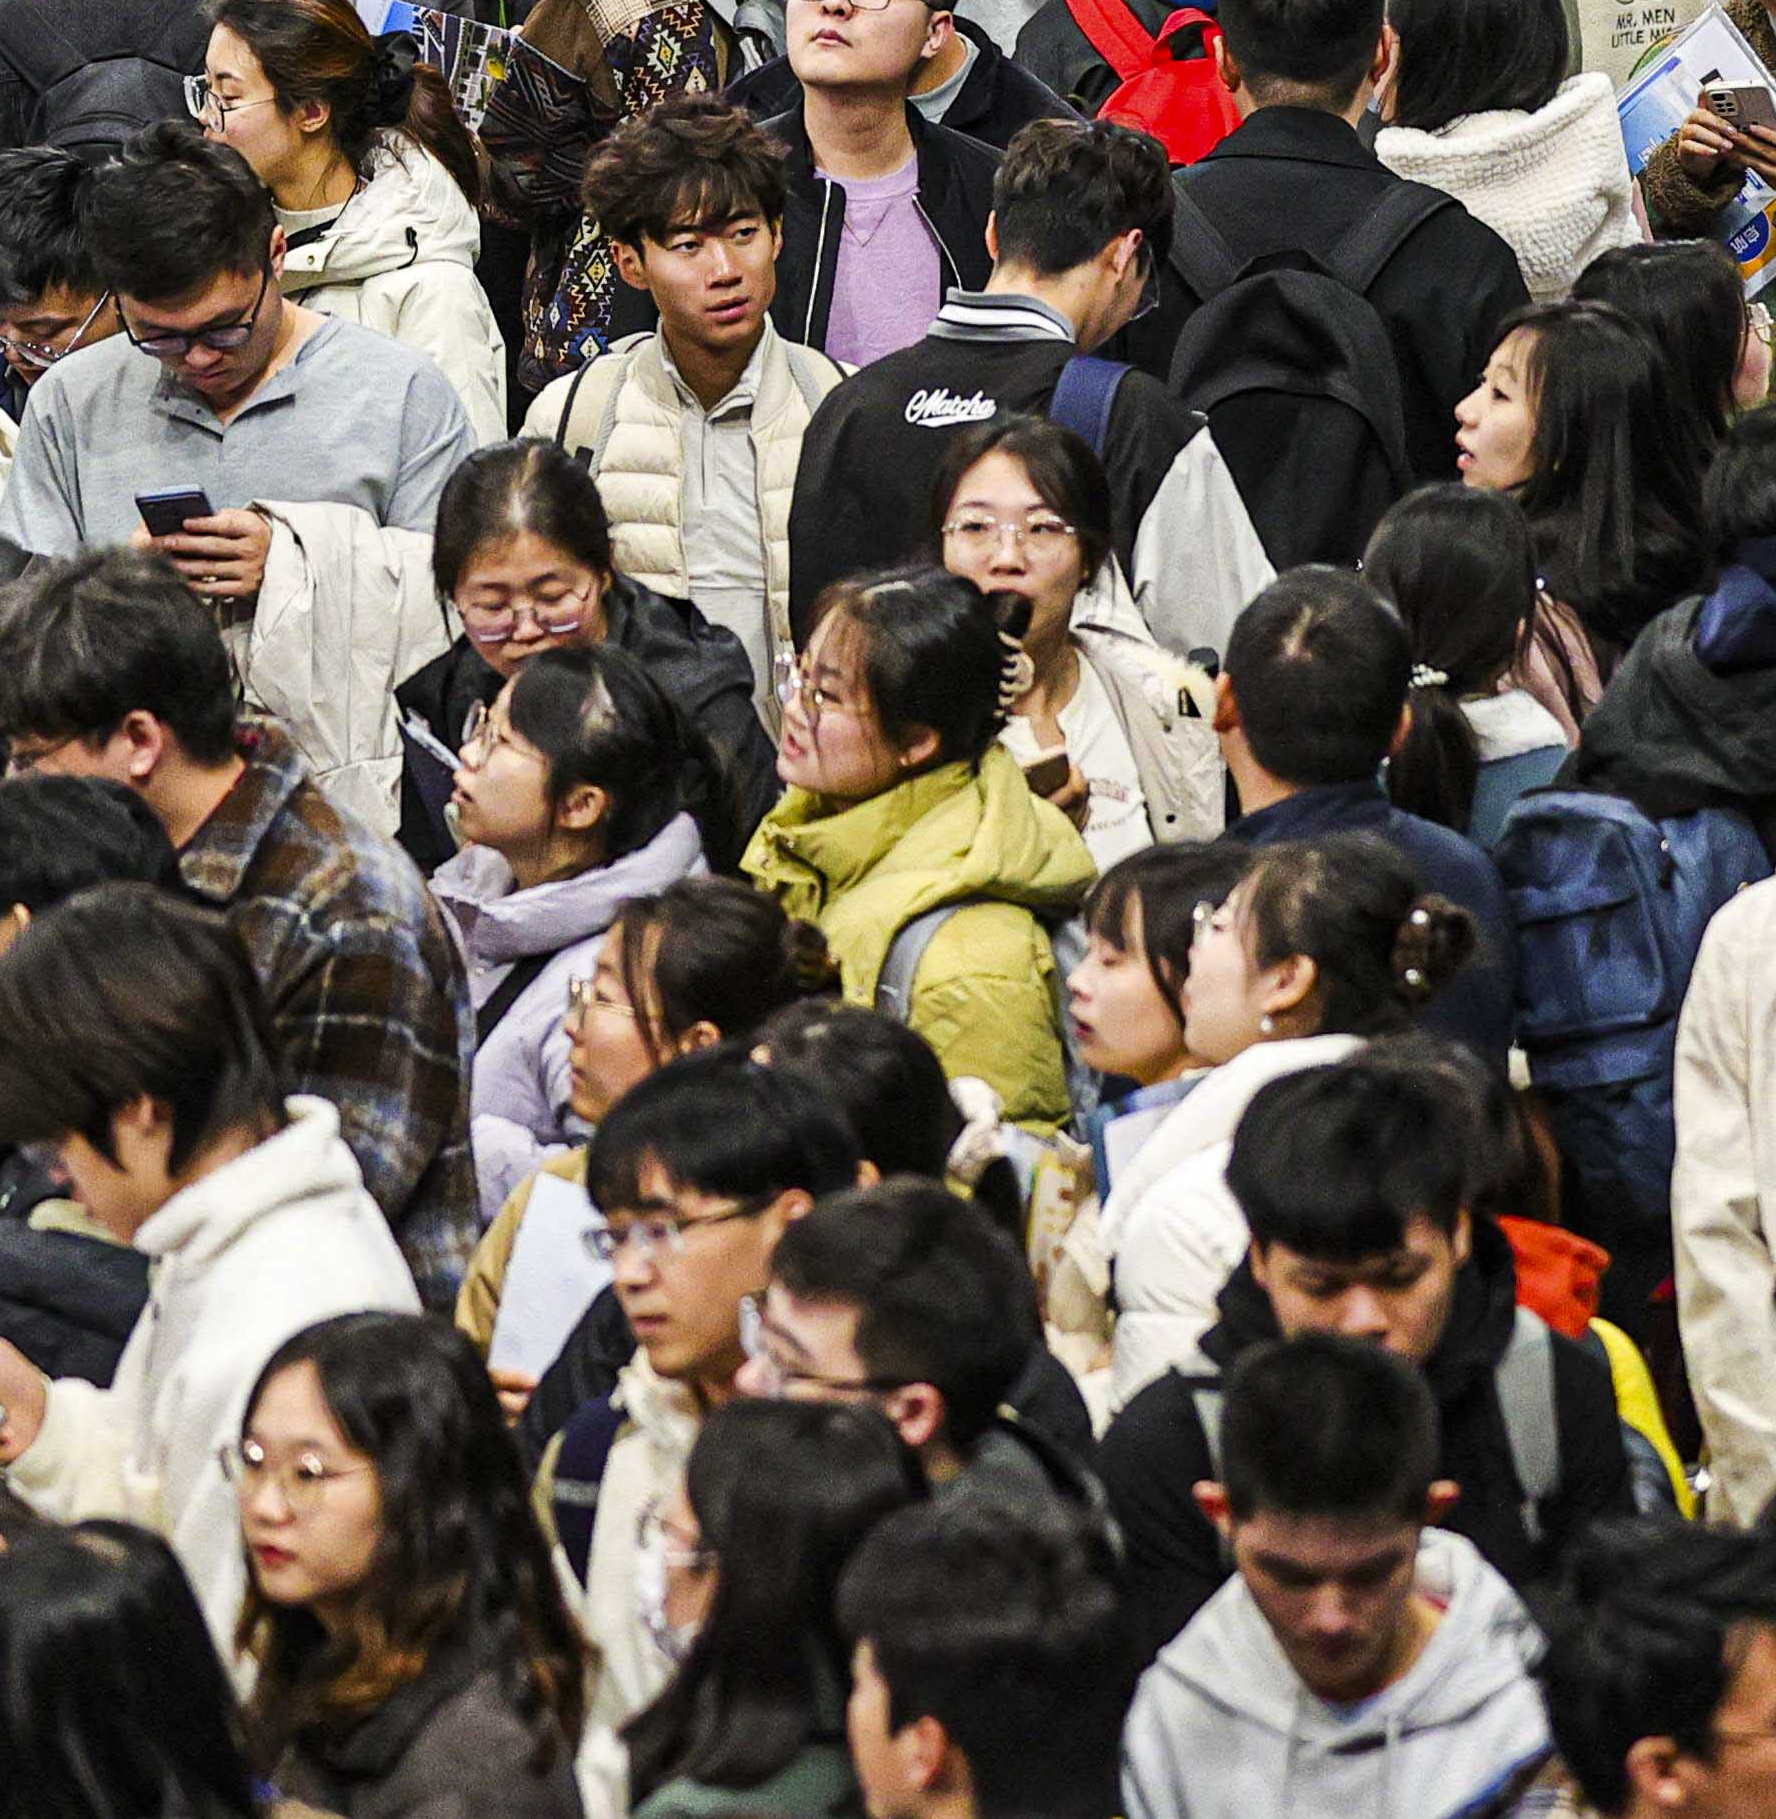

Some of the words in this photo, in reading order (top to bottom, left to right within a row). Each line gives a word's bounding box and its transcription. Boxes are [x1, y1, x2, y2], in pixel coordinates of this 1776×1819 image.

[1642, 8, 1675, 26] MEN
[1611, 30, 1644, 48] LITTLE
[1649, 26, 1674, 42] MI
